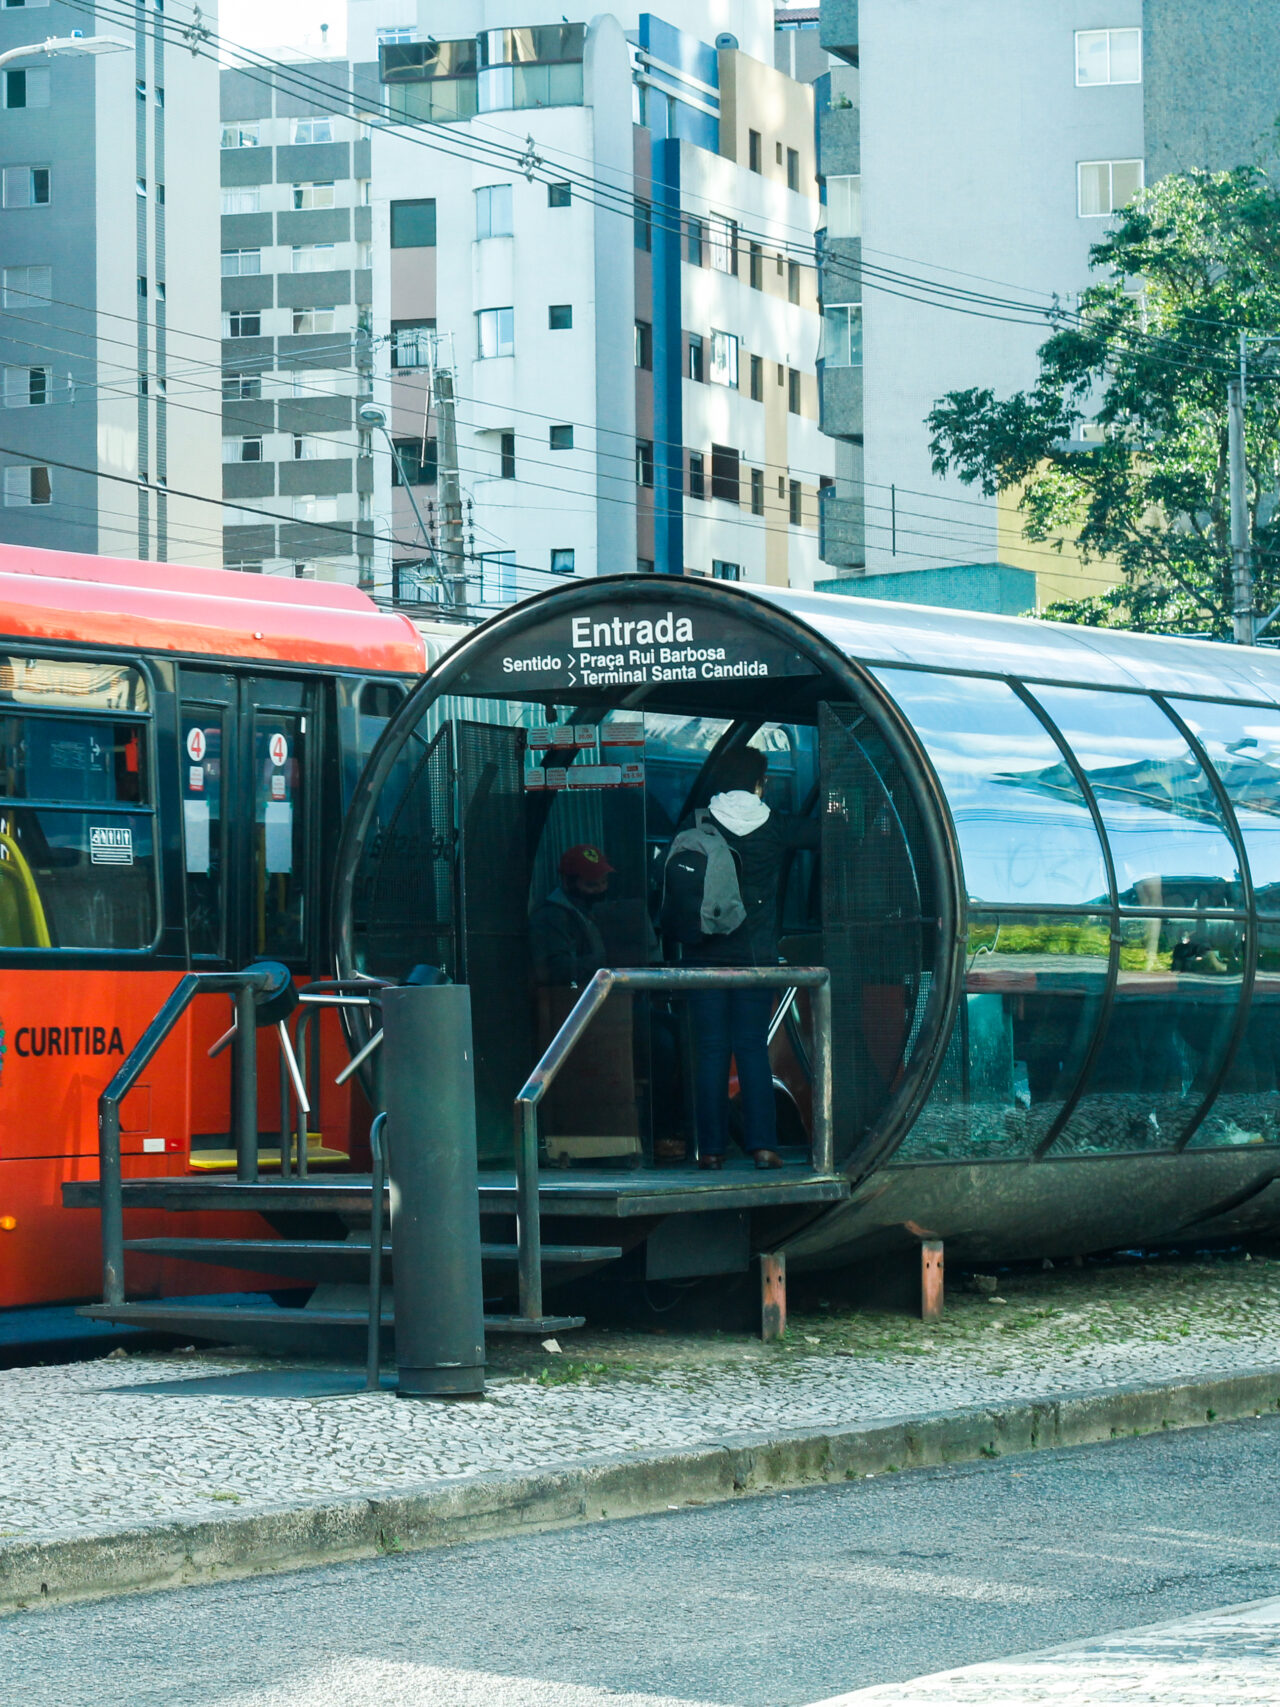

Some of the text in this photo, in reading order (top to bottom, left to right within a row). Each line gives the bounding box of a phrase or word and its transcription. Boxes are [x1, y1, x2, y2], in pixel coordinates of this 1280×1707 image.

[571, 611, 693, 648] Entrada
[502, 646, 726, 673] Sentido Praça Rui Barbosa
[580, 660, 769, 685] Terminal Santa Candida
[191, 731, 202, 758] 4
[273, 737, 284, 763] 4
[14, 1026, 125, 1057] CURITIBA
